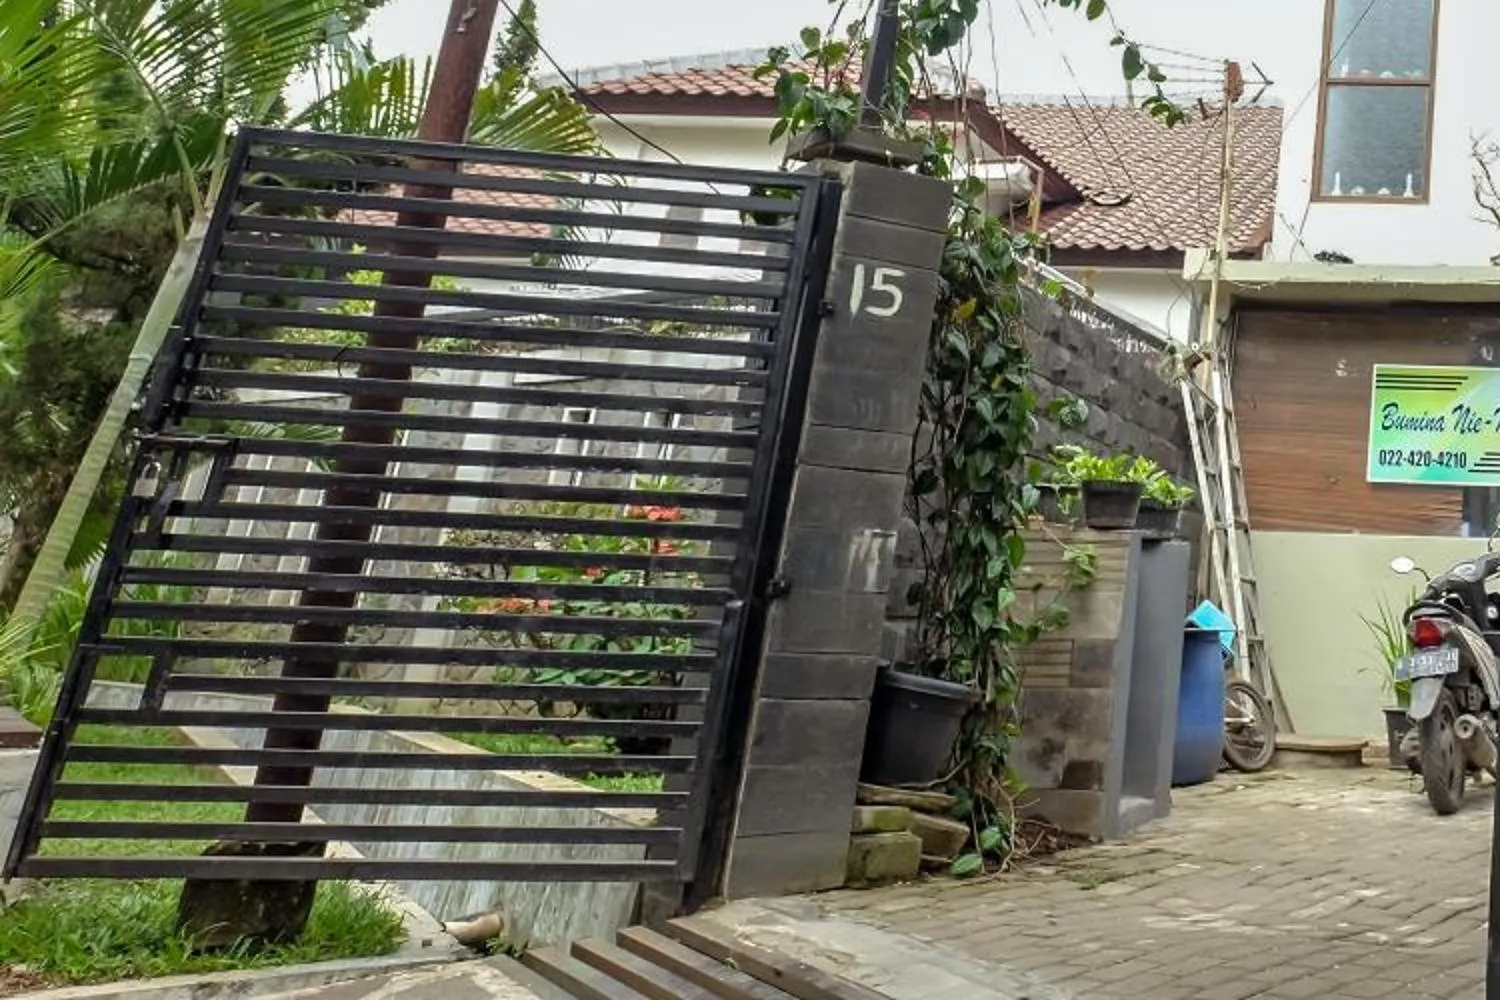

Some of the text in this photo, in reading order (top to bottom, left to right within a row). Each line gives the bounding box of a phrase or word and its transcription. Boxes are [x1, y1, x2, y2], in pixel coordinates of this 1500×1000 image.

[849, 263, 905, 318] 15
[1381, 402, 1445, 432] Bumina
[1378, 449, 1467, 469] 022-420-4210
